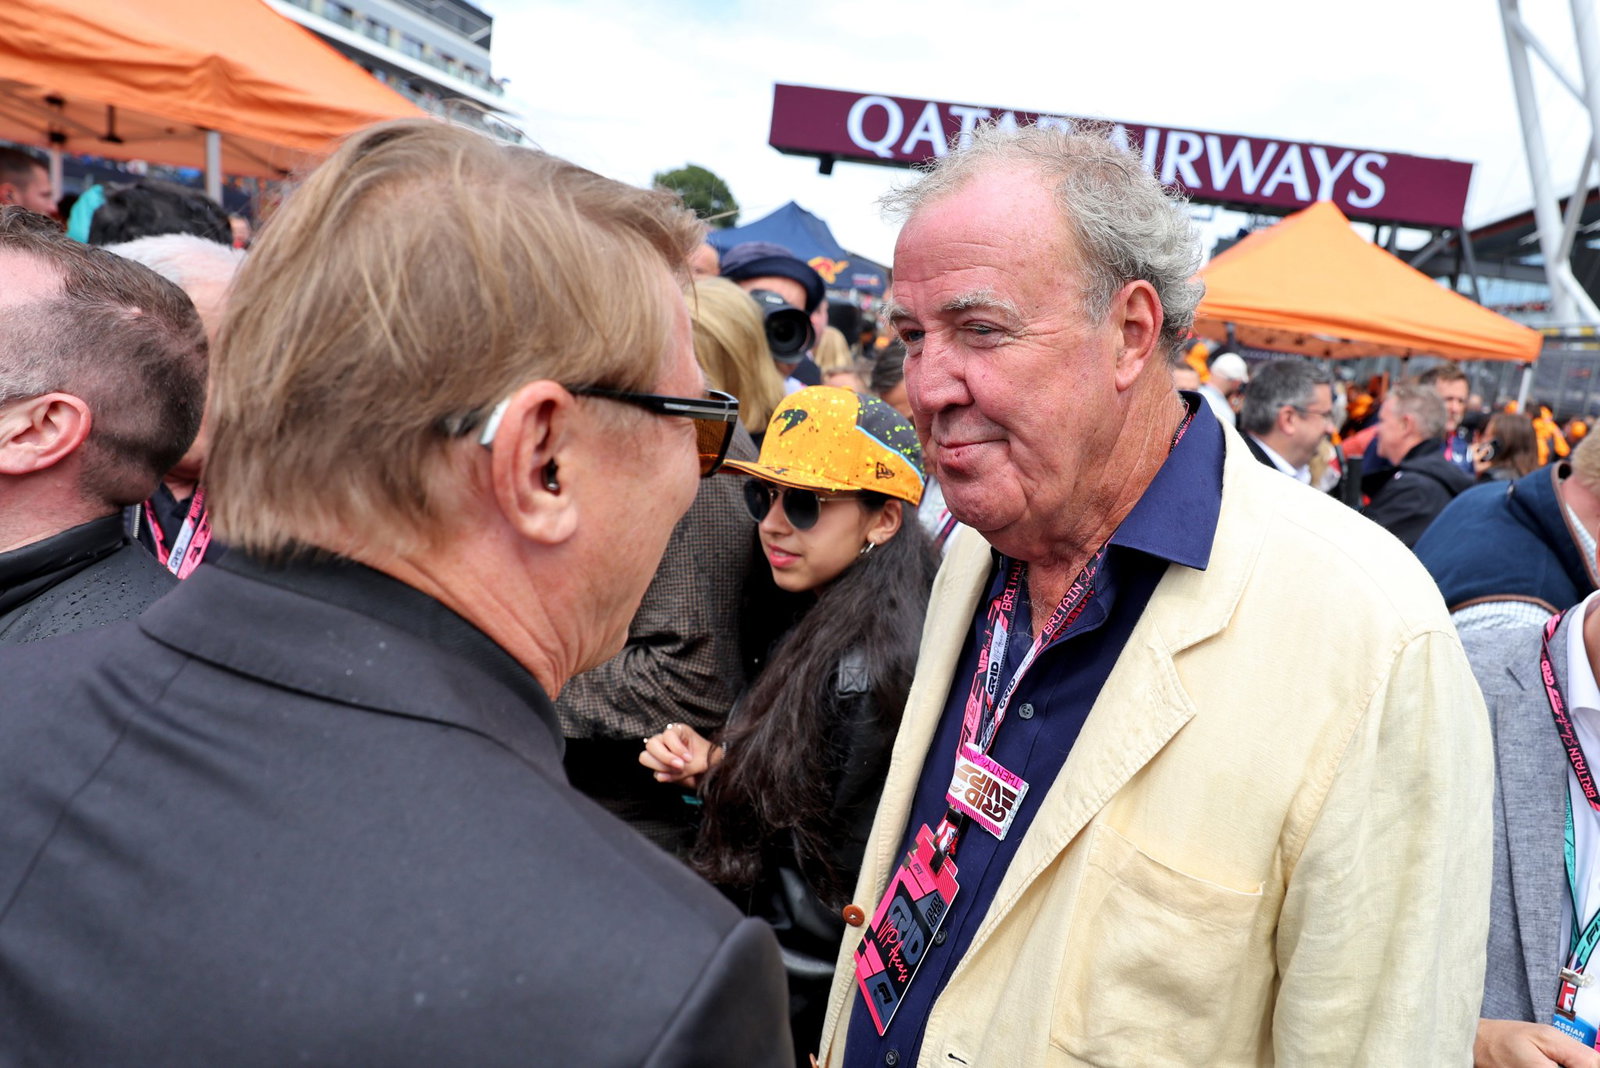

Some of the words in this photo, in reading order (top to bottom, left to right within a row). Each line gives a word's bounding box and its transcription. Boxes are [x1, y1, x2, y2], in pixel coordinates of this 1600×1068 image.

[1042, 582, 1084, 635] BRITAIN
[977, 649, 988, 674] VIP
[1541, 660, 1555, 686] GRID
[987, 662, 1000, 695] GRID
[1000, 678, 1015, 710] GRID
[968, 774, 1001, 804] VIP
[1568, 747, 1597, 798] BRITAIN
[965, 787, 1006, 823] GRID
[877, 915, 899, 948] VIP
[887, 895, 925, 966] GRID
